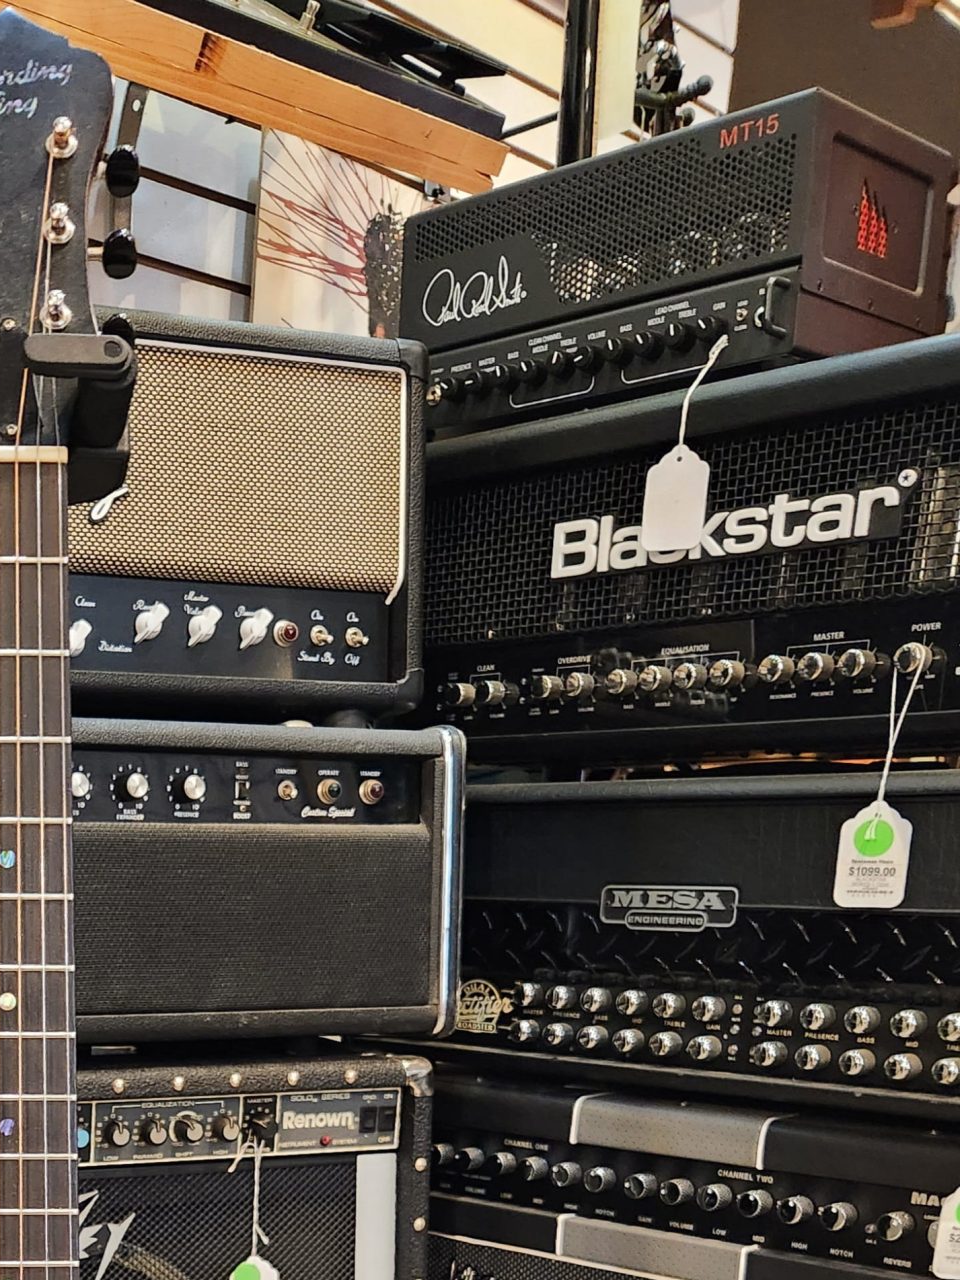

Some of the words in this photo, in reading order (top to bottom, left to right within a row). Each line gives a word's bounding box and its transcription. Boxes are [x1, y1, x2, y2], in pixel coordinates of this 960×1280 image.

[720, 113, 780, 149] MT15
[911, 622, 942, 633] POWER
[813, 631, 845, 642] MASTER
[661, 644, 710, 656] EQUALISATION
[557, 655, 592, 665] OVERDRIVE
[476, 664, 496, 672] CLEAN
[848, 866, 897, 877] $1099.00
[611, 889, 727, 911] MESA
[627, 915, 704, 927] ENGINEERING
[464, 981, 490, 994] DUAL
[459, 994, 514, 1023] ectifier
[767, 1029, 793, 1037] MASTER
[804, 1032, 840, 1042] PRESENCE
[141, 1100, 195, 1109] EQUALIZATION
[282, 1110, 356, 1130] Renown
[717, 1169, 753, 1182] CHANNEL
[756, 1175, 774, 1185] TWO
[712, 1228, 727, 1236] LOW
[791, 1241, 808, 1250] HIGH
[829, 1247, 854, 1258] NOTCH
[883, 1256, 912, 1268] REVERB
